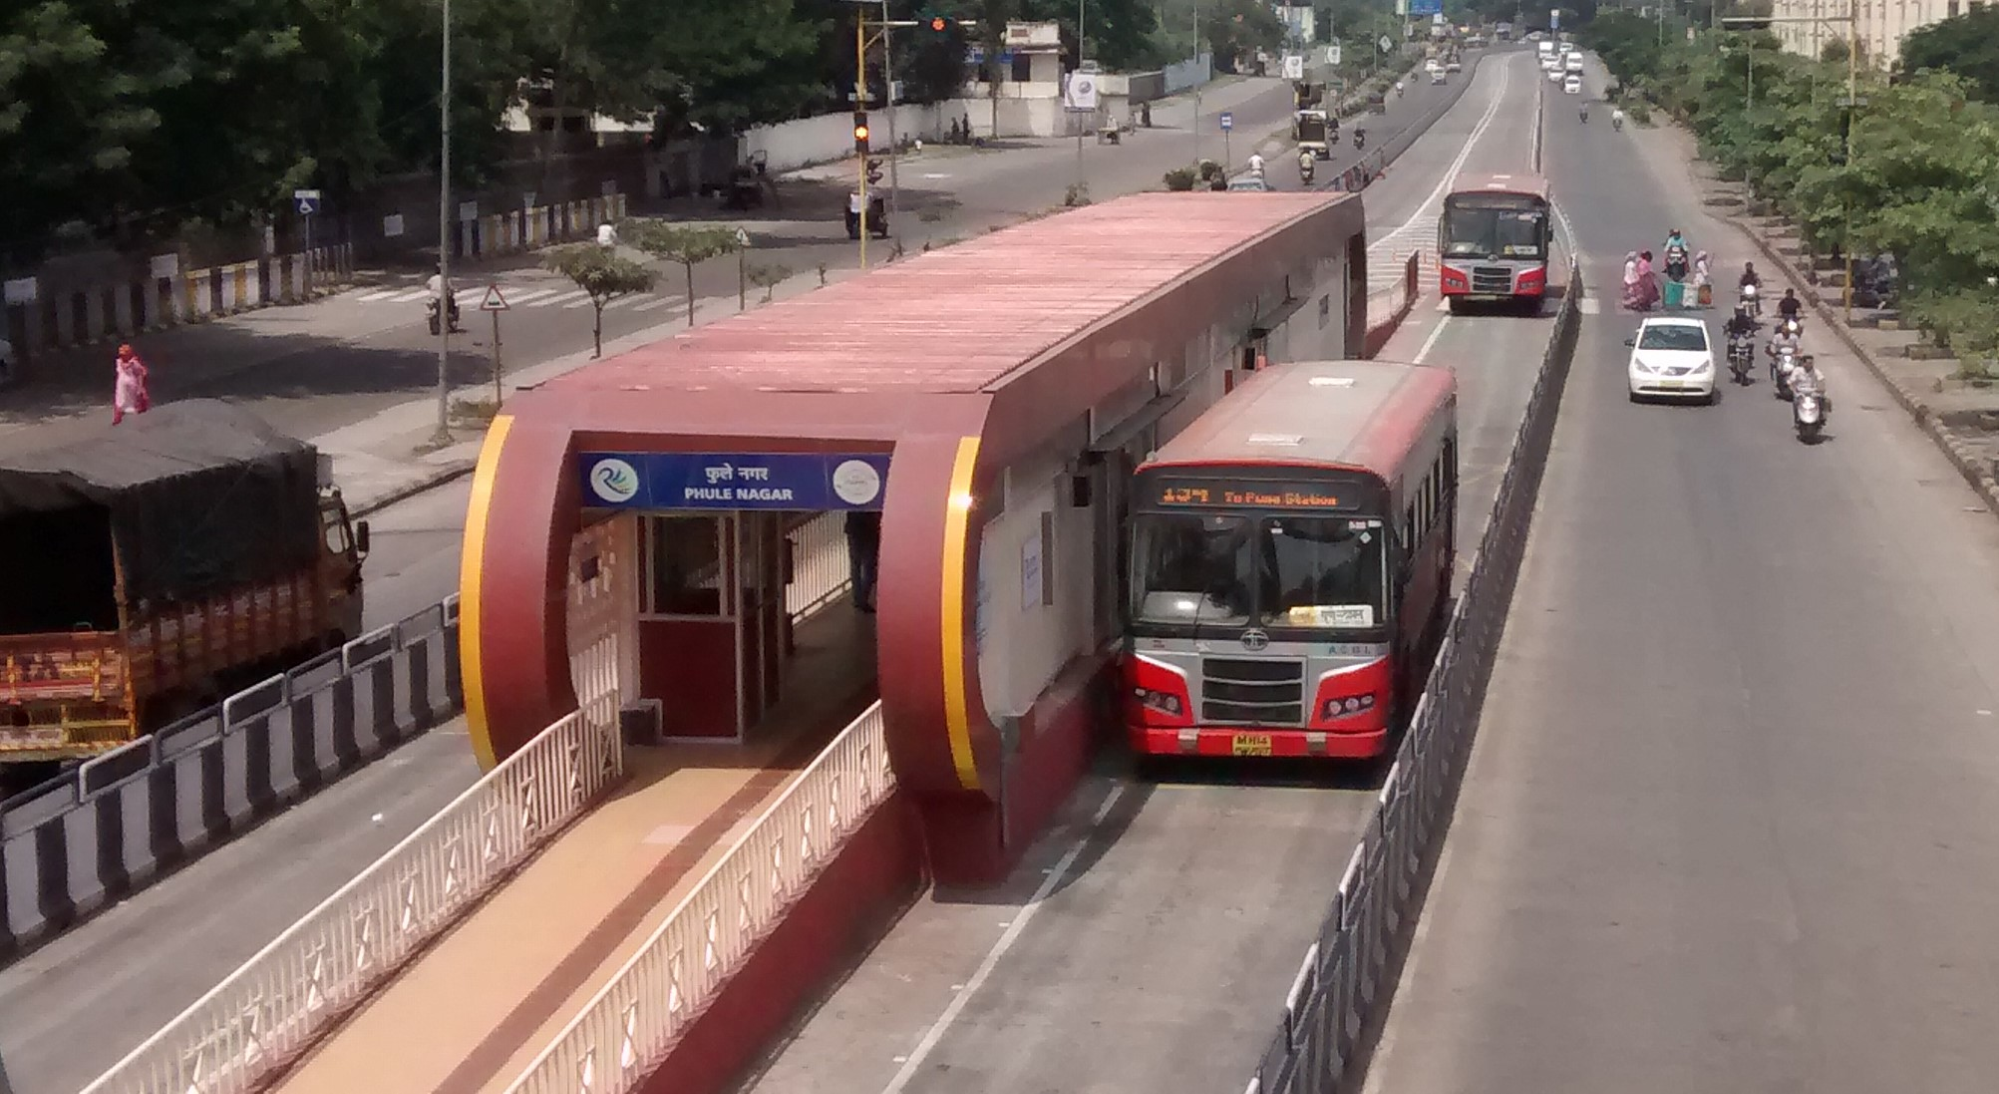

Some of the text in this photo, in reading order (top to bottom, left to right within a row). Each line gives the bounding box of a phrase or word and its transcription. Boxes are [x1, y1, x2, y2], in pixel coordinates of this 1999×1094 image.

[705, 462, 769, 484] फुले नगर
[684, 487, 793, 500] PHULE NAGAR
[1225, 491, 1242, 503] To
[1245, 492, 1281, 505] Pune
[1285, 493, 1338, 506] Station
